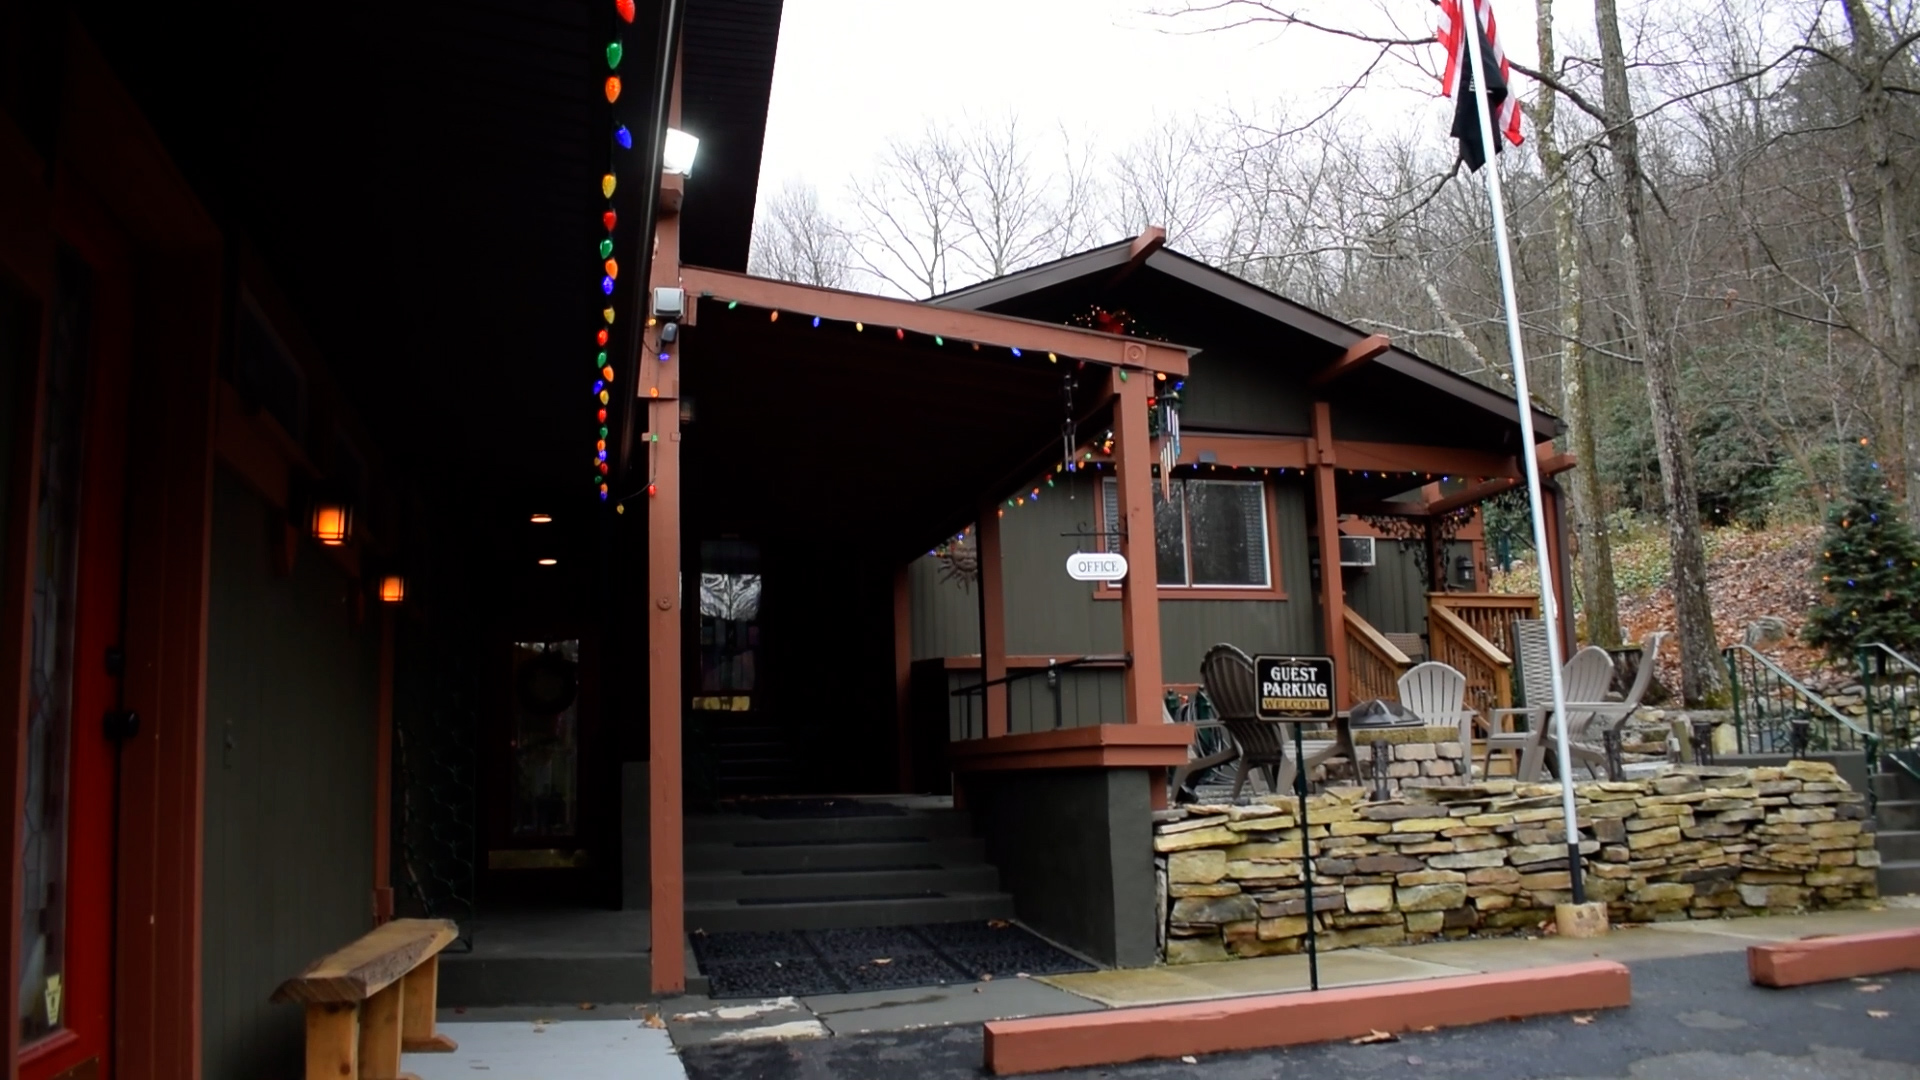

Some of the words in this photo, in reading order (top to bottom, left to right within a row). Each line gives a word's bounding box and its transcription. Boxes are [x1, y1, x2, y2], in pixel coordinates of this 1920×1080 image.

[1078, 561, 1119, 573] OFFICE
[1270, 666, 1318, 682] GUEST
[1263, 682, 1327, 697] PARKING
[1264, 699, 1327, 709] WELCOME
